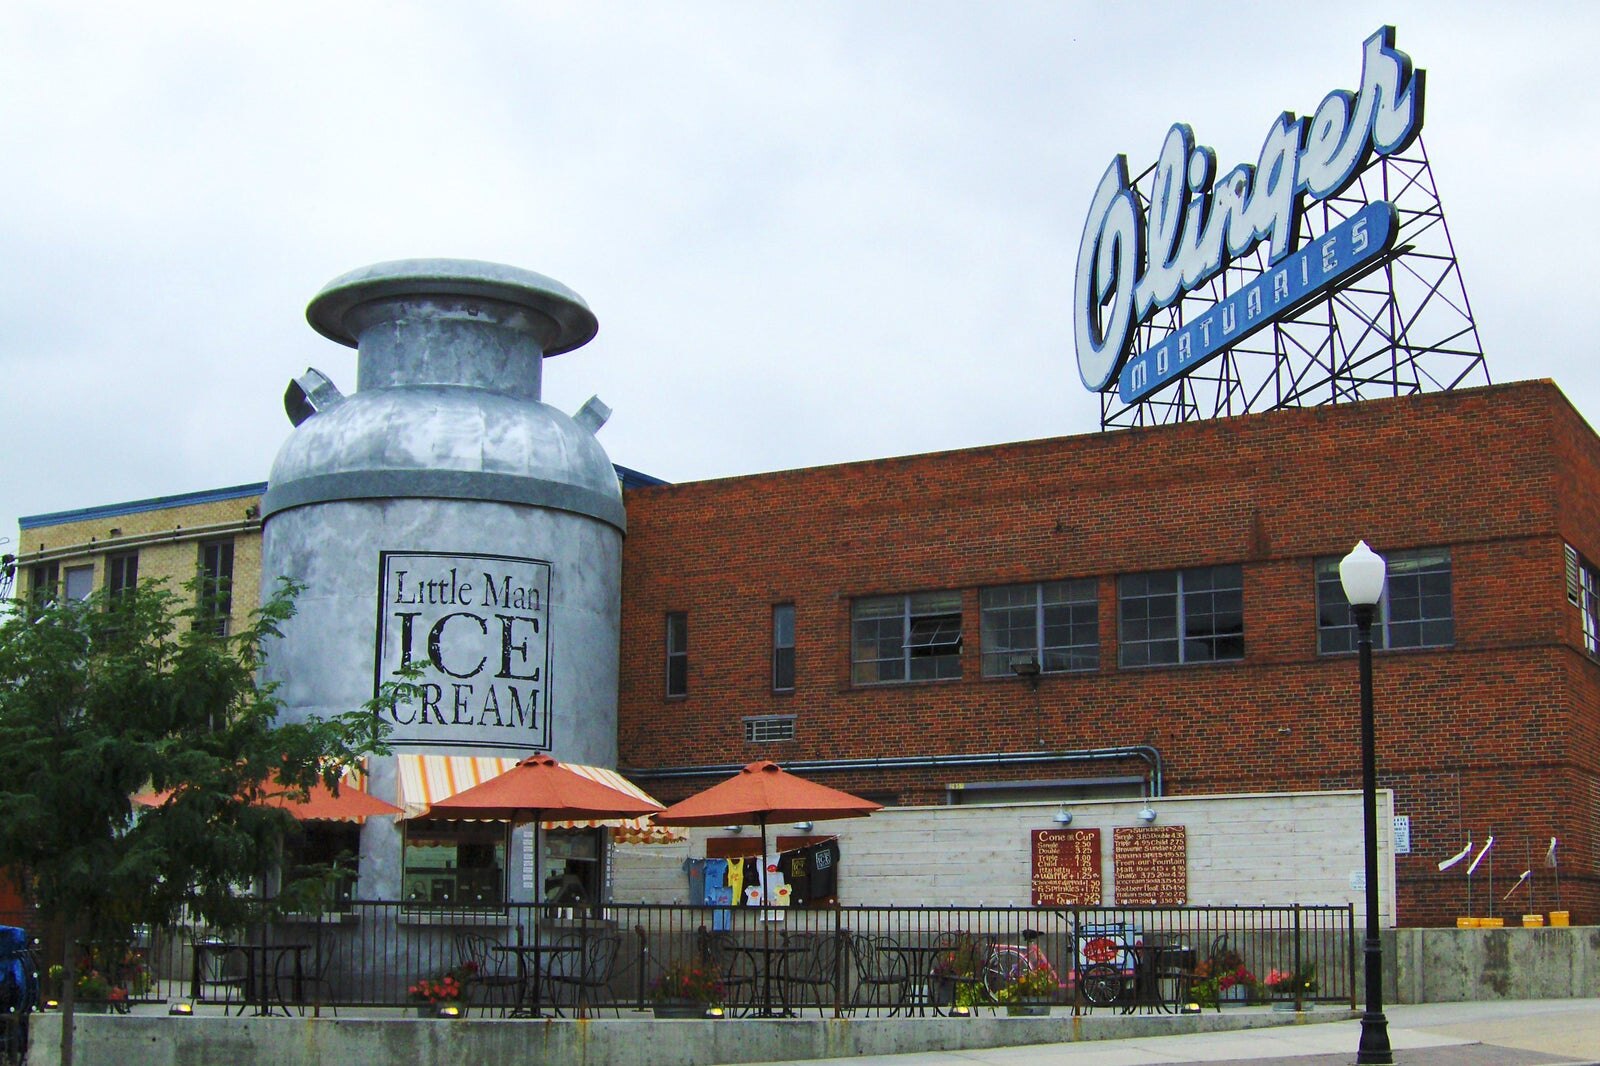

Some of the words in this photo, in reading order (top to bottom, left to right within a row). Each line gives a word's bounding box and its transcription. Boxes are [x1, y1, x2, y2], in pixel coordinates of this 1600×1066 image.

[1074, 25, 1426, 393] Olinger
[1130, 216, 1368, 392] MORTUARIES
[394, 568, 472, 605] Little
[481, 572, 541, 611] Man
[392, 612, 540, 682] ICE
[390, 683, 540, 730] CREAM
[1039, 830, 1066, 841] Cone
